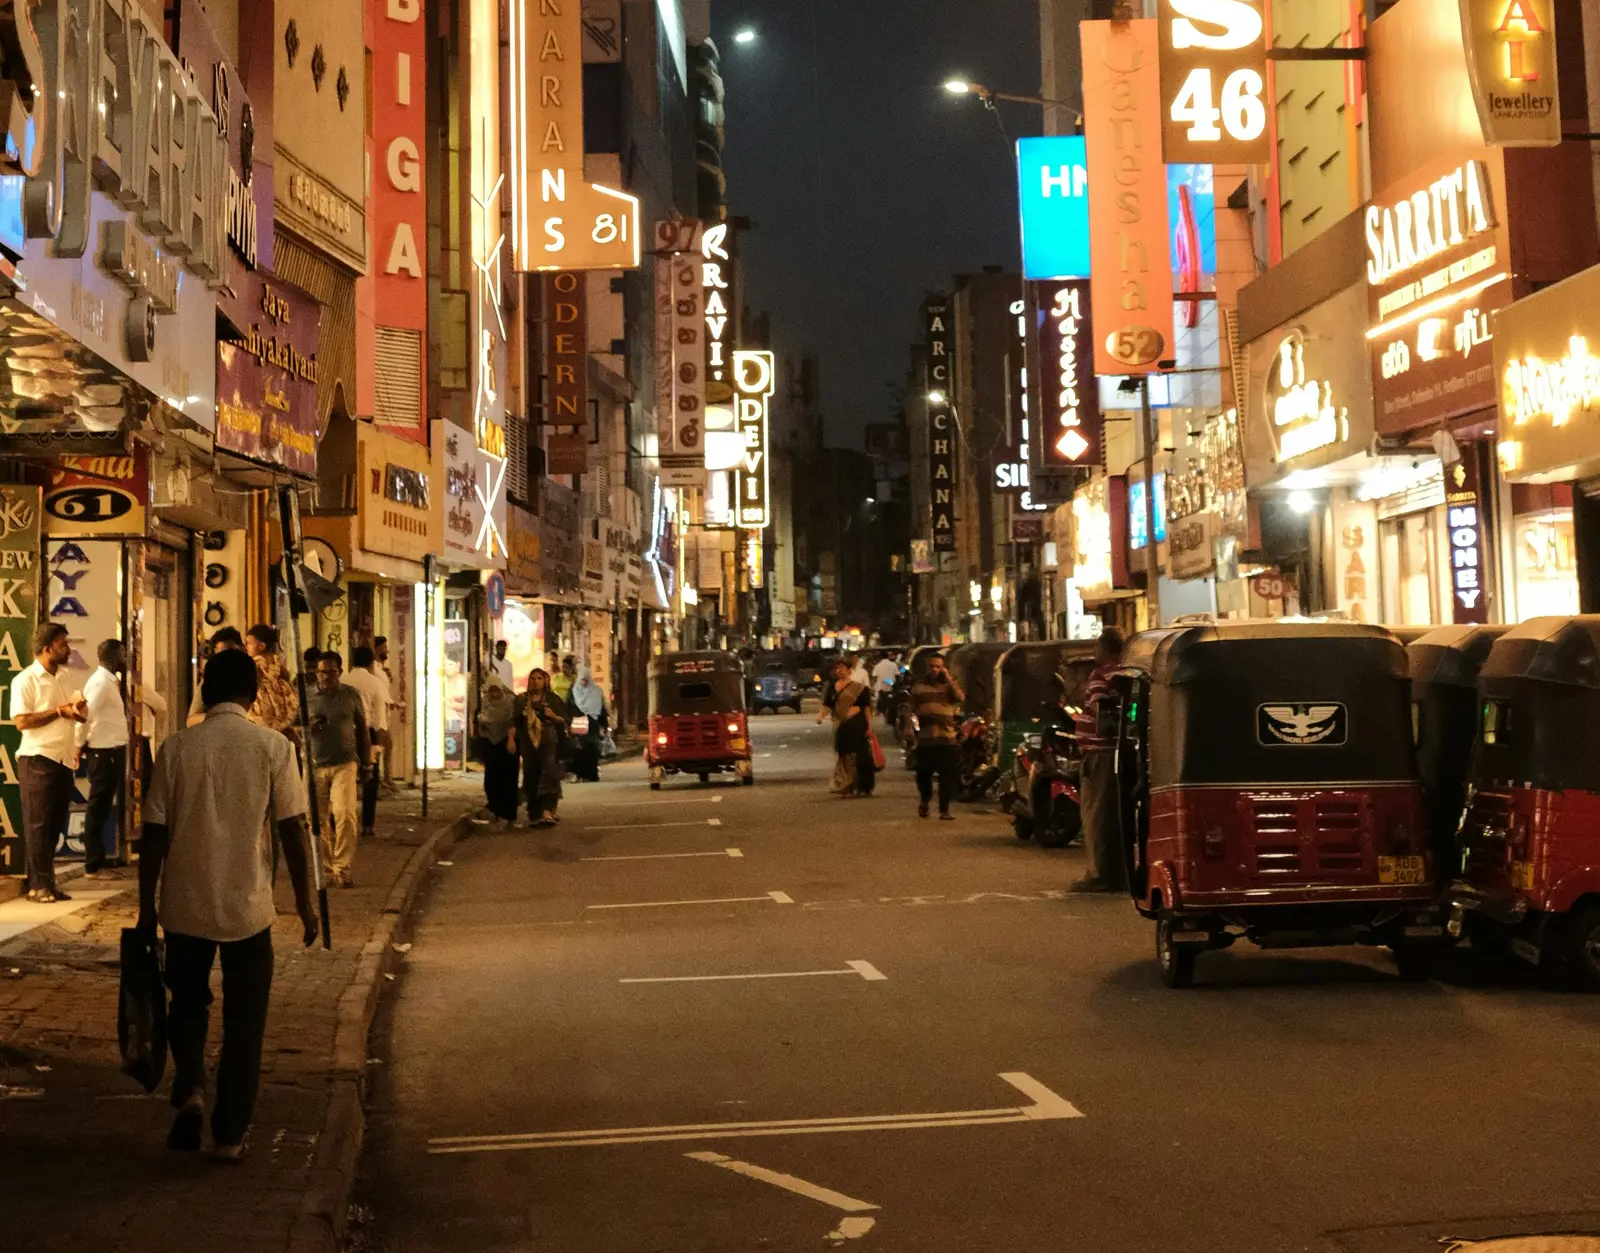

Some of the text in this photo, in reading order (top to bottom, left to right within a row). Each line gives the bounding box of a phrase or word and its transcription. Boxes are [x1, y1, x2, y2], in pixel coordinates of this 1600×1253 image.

[1170, 68, 1266, 142] 46
[1489, 92, 1554, 114] Jewellery
[591, 213, 627, 243] 81
[658, 223, 699, 251] 97
[1365, 159, 1488, 286] SARRITA
[1118, 330, 1151, 360] 52
[930, 316, 950, 529] ARCCHANA
[740, 399, 763, 500] DEVI
[54, 493, 113, 517] 61
[1450, 506, 1480, 609] MONEY
[1259, 579, 1283, 595] 50
